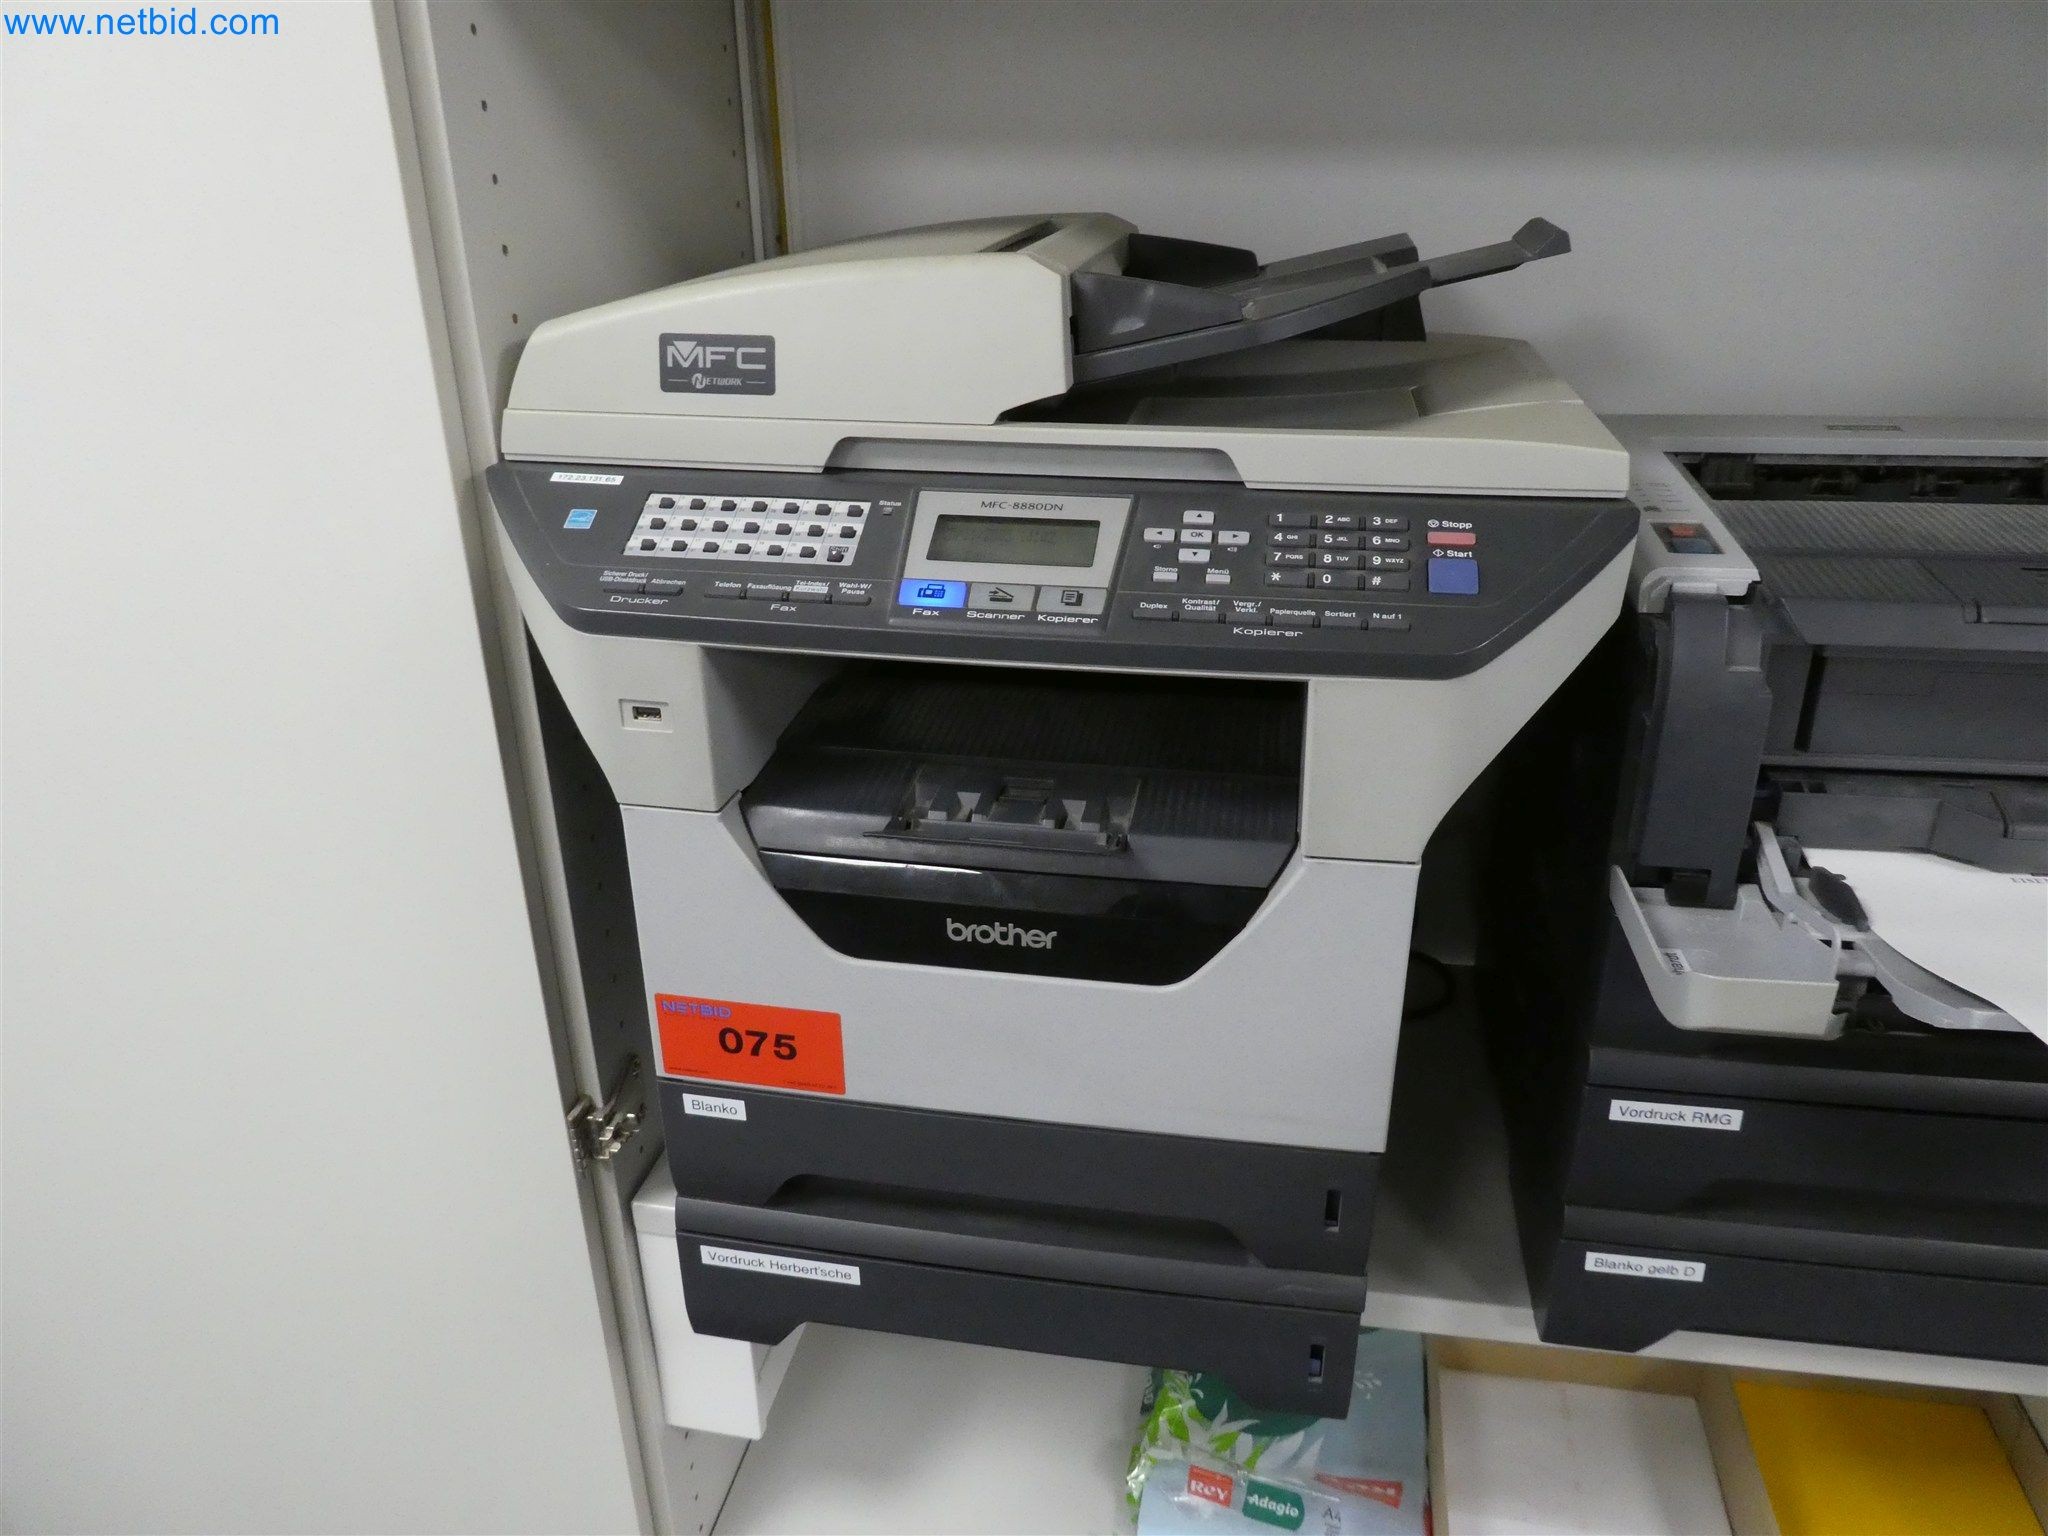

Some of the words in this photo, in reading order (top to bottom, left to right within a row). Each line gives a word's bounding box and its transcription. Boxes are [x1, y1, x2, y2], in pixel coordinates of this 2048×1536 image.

[667, 342, 766, 369] MFC
[980, 500, 1064, 511] MFC-8880DN
[1276, 513, 1283, 522] 1
[1325, 515, 1333, 524] 2
[1372, 517, 1381, 526] 3
[1441, 520, 1473, 529] Stopp
[1274, 533, 1283, 541] 4
[1323, 534, 1333, 543] 5
[1372, 536, 1381, 545] 6
[1273, 552, 1282, 561] 7
[1446, 549, 1473, 558] Start
[1323, 554, 1332, 563] 8
[1372, 556, 1381, 565] 9
[1206, 567, 1230, 575] Menü
[1322, 574, 1332, 584] 0
[609, 595, 669, 605] Drucker
[1181, 598, 1220, 606] Kontrast/
[1233, 600, 1262, 608] Vergr./
[770, 603, 797, 612] Fax
[1139, 602, 1168, 610] Duplex
[912, 607, 940, 616] Fax
[966, 610, 1026, 620] Scanner
[1269, 608, 1316, 616] Papierquelle
[1324, 610, 1356, 618] Sortiert
[1037, 613, 1099, 624] Kopierer
[1233, 627, 1303, 637] Kopierer
[946, 918, 1057, 949] brother
[662, 1001, 732, 1019] NETBID
[719, 1027, 798, 1061] 075
[691, 1099, 738, 1116] Blanko
[1619, 1105, 1687, 1122] Vordruck
[1691, 1111, 1733, 1125] RMG
[707, 1250, 765, 1268] Vordruck
[769, 1259, 852, 1280] Herbert'sche
[1593, 1257, 1644, 1273] Blanko
[1647, 1263, 1680, 1275] gelb
[1683, 1266, 1696, 1277] D
[1246, 1494, 1299, 1518] Adagio
